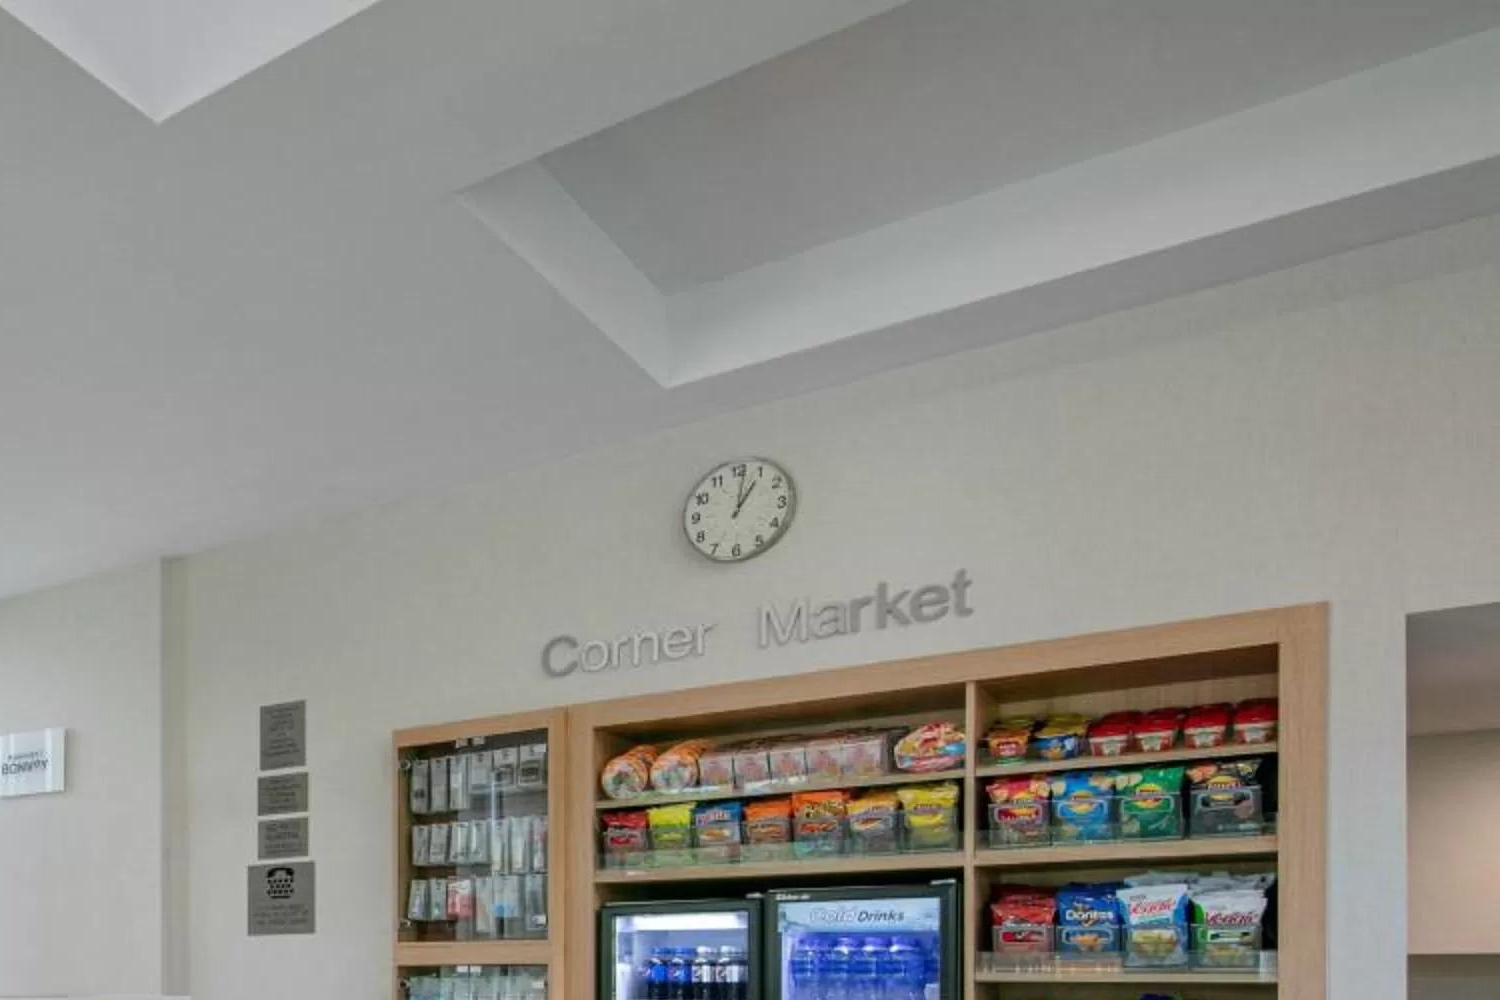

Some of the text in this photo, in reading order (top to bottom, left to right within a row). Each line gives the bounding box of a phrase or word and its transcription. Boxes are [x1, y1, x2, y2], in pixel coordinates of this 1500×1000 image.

[731, 464, 747, 478] 12
[757, 466, 764, 478] 1
[712, 475, 723, 488] 11
[771, 476, 782, 489] 2
[695, 492, 709, 506] 10
[777, 495, 787, 510] 3
[691, 511, 701, 525] 9
[769, 516, 779, 528] 4
[696, 530, 705, 544] 8
[755, 533, 765, 548] 5
[710, 543, 720, 556] 7
[731, 543, 741, 557] 6
[541, 567, 975, 678] Corner Market
[857, 909, 905, 922] Drinks
